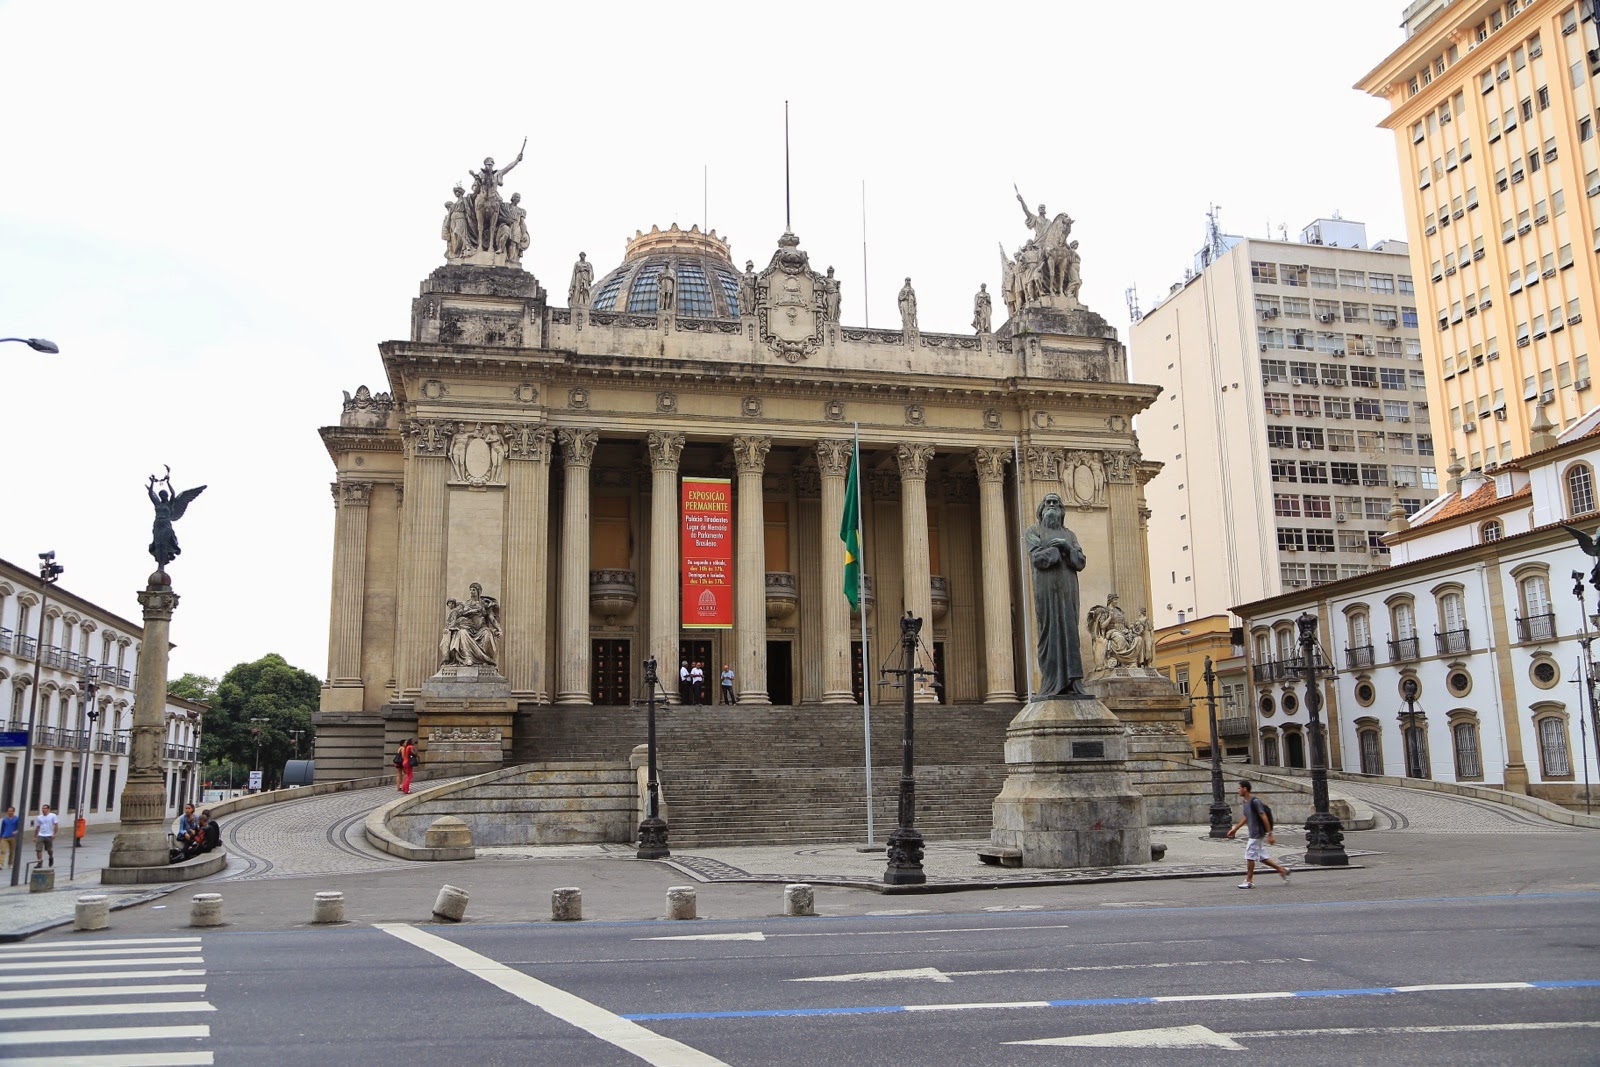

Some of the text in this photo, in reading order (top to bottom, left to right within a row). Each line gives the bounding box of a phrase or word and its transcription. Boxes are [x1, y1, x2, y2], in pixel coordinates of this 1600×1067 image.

[688, 490, 725, 501] EXPOSIÇÃO
[685, 501, 728, 511] PERMANENTE
[704, 515, 728, 523] Tiradentes
[686, 523, 699, 531] Lugar
[707, 523, 728, 531] Memória
[697, 531, 724, 539] Parlamento
